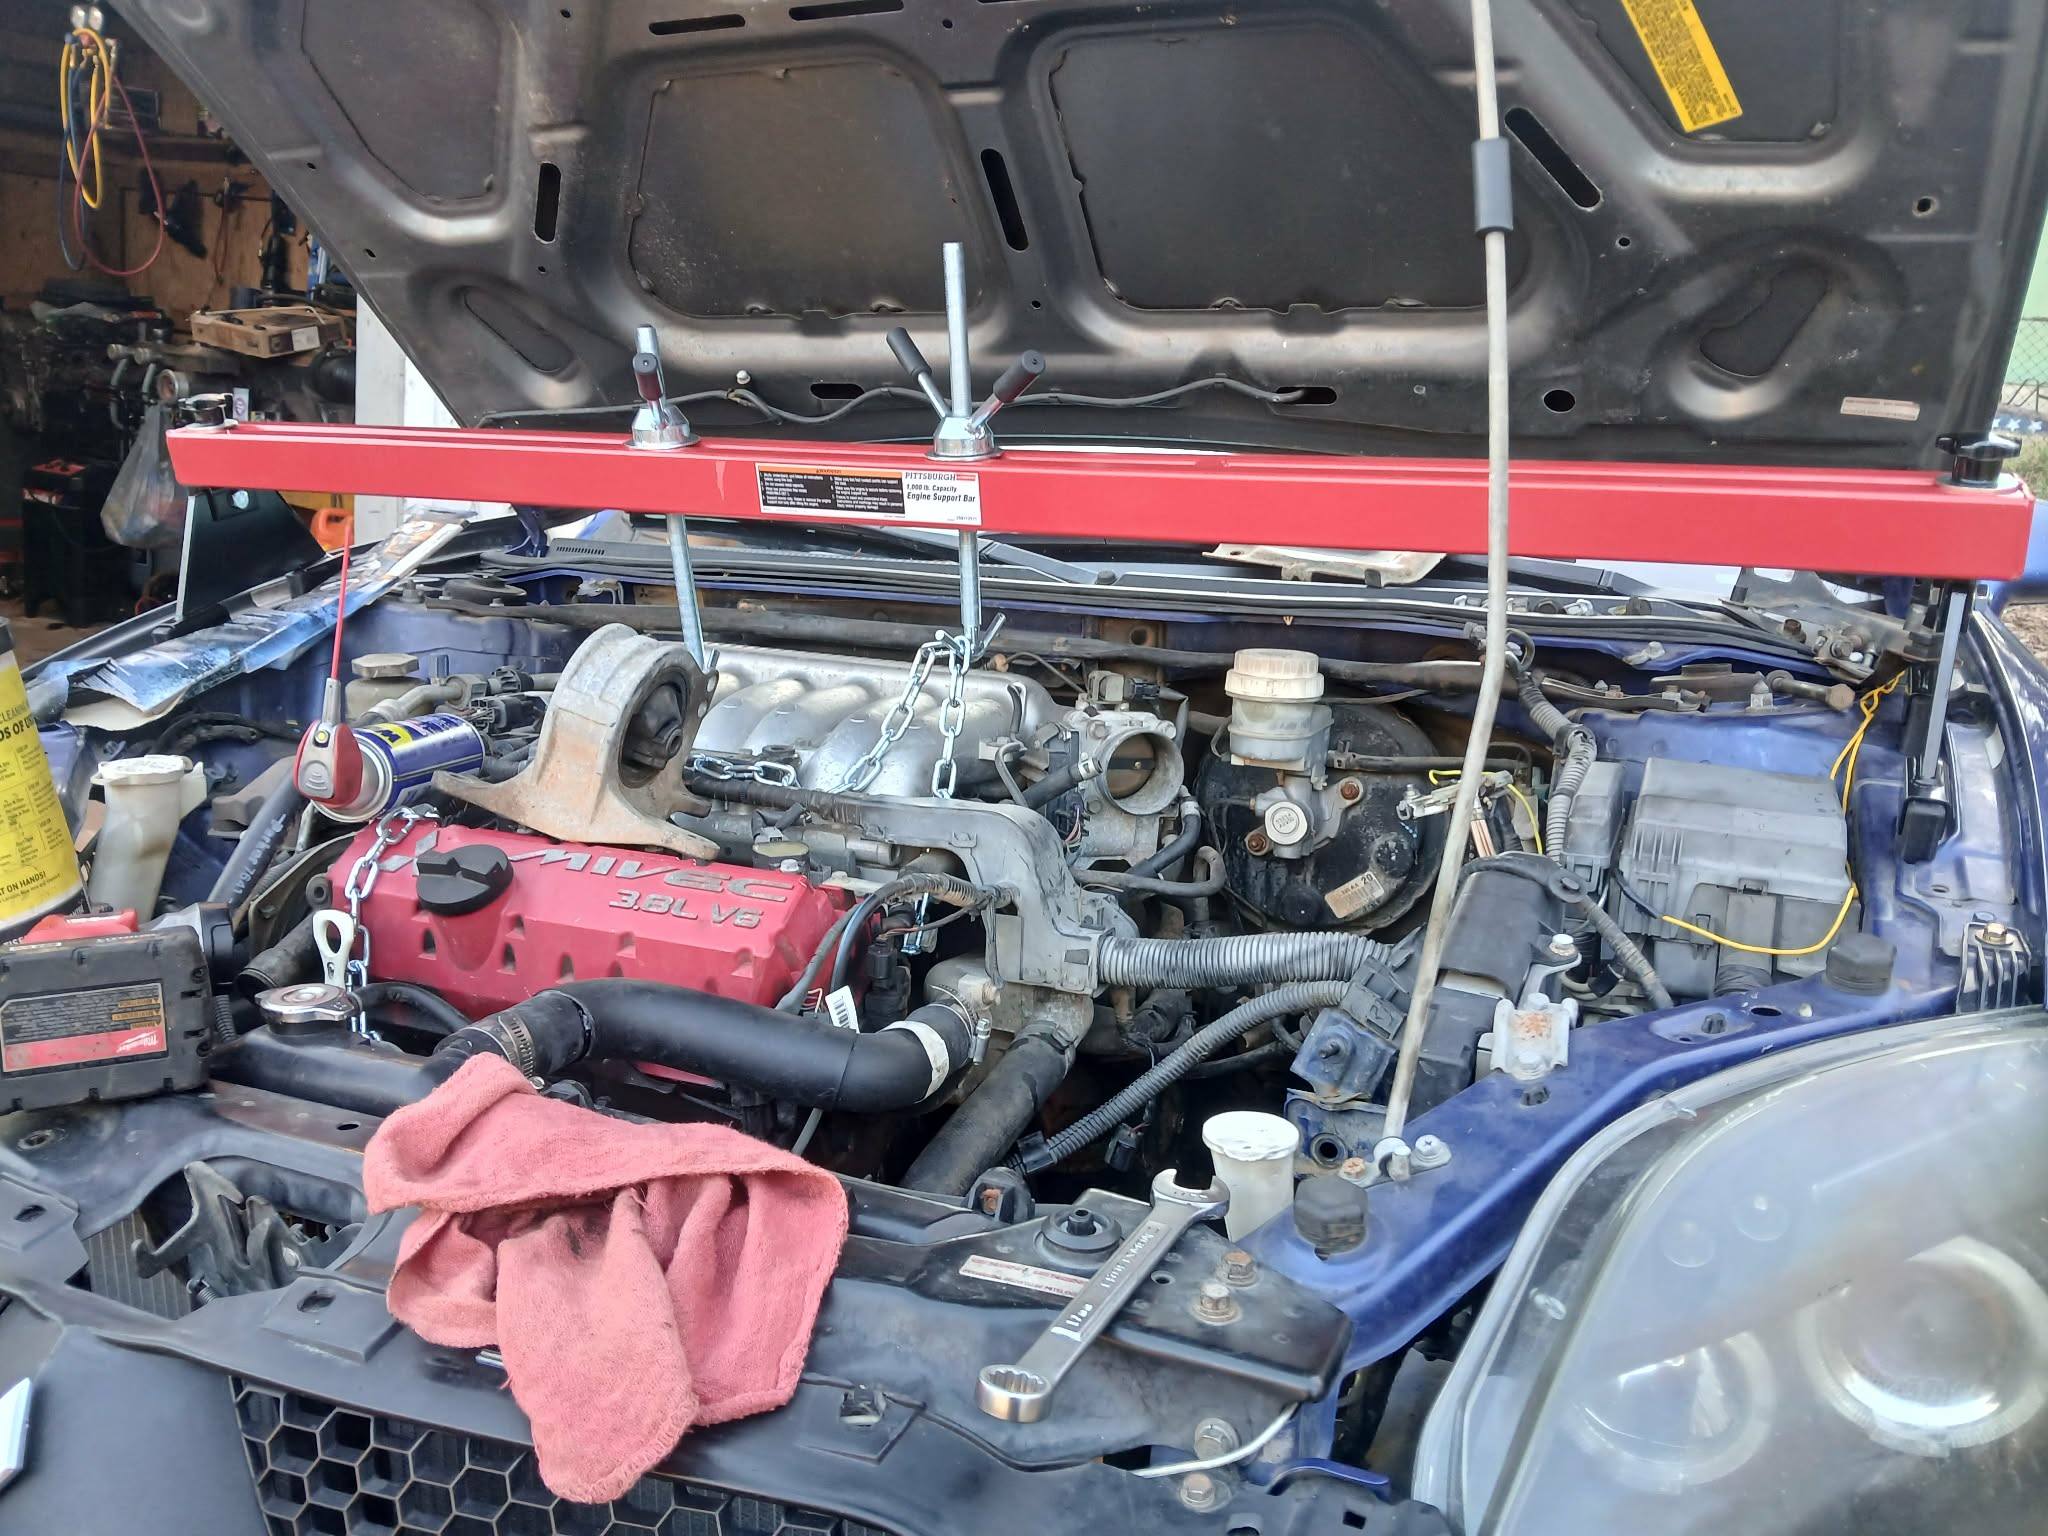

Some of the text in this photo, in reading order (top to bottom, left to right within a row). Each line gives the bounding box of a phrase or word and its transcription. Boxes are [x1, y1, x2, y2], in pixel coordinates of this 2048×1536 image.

[905, 472, 956, 481] PITTSBURGH
[932, 485, 957, 493] Capacity
[907, 492, 931, 501] Engine
[933, 493, 961, 502] Support
[233, 818, 284, 894] Parker 7641
[508, 849, 794, 902] MIVEC
[7, 882, 19, 893] ON
[609, 889, 764, 928] 3.8L V6
